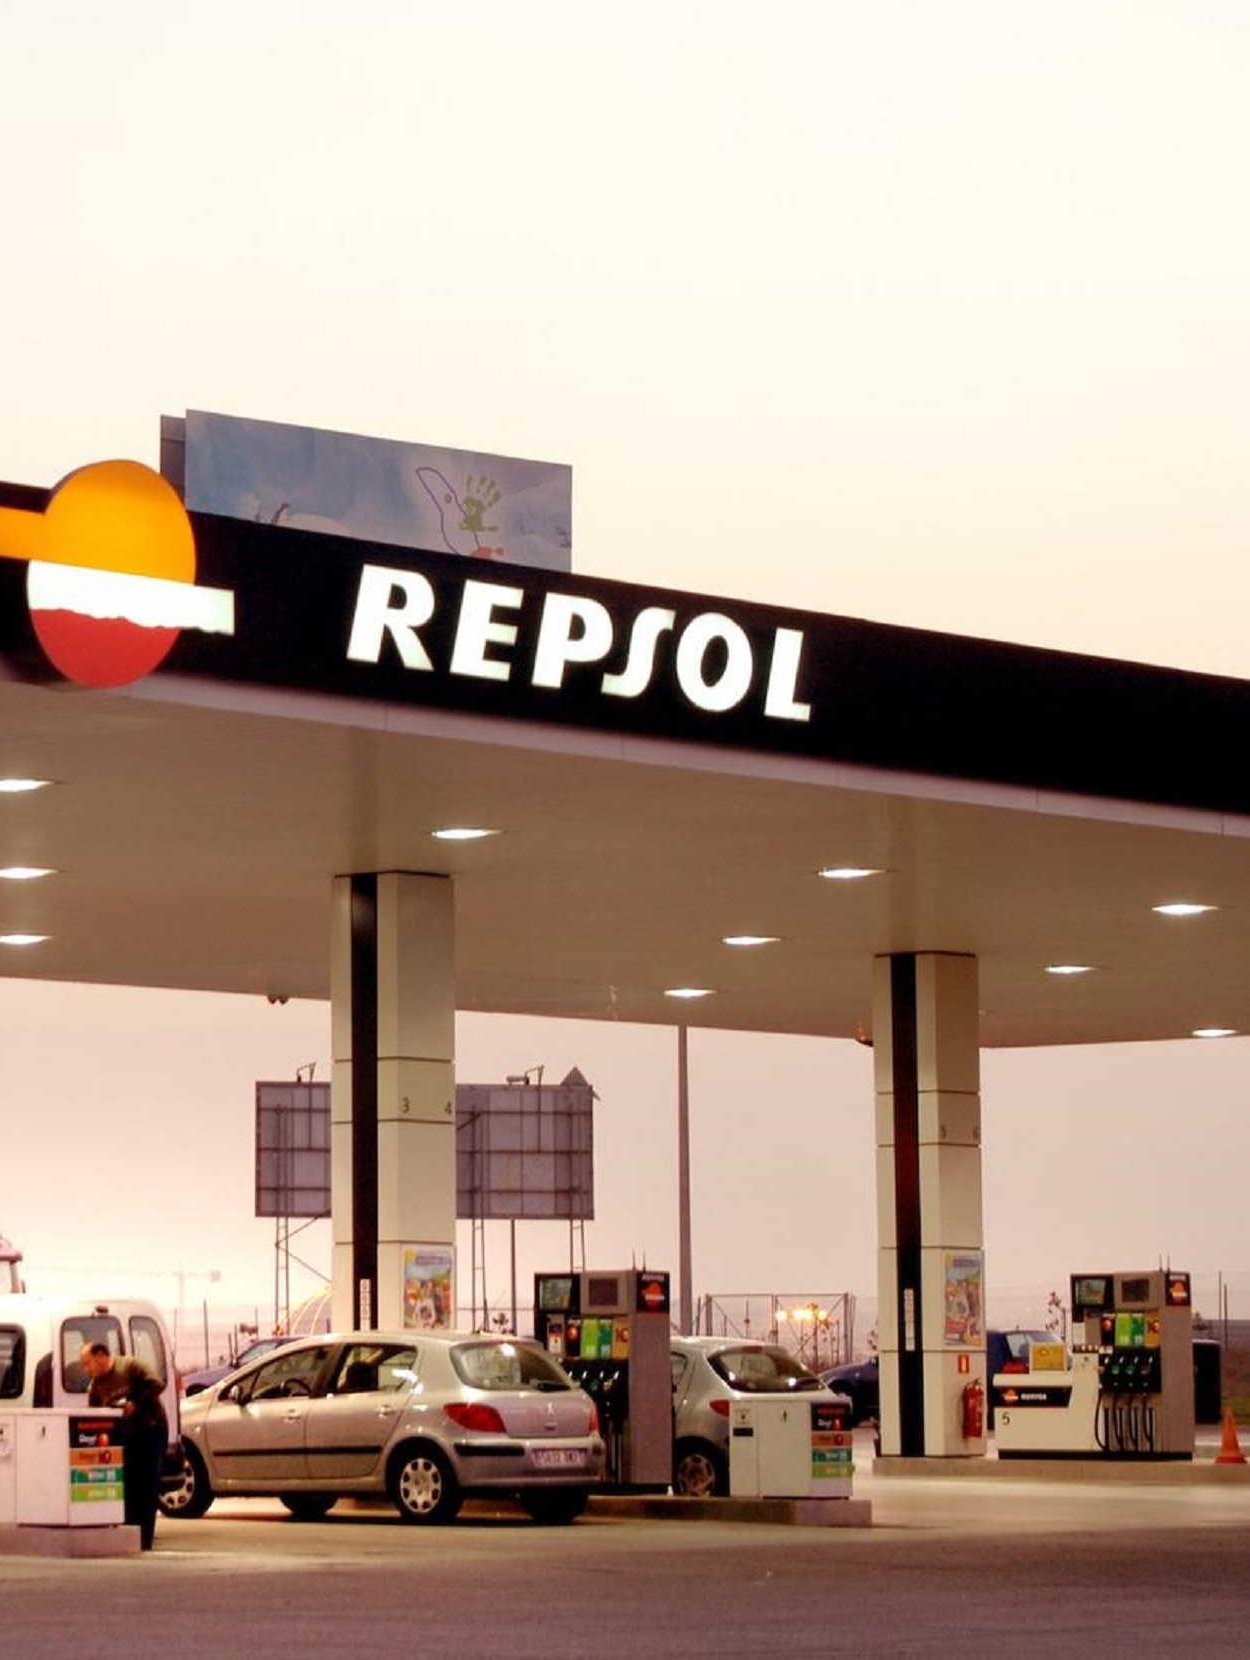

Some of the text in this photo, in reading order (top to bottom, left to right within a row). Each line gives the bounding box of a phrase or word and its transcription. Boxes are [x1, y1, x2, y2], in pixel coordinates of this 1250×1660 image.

[346, 563, 811, 722] REPSOL
[401, 1096, 410, 1113] 3
[1001, 1411, 1011, 1426] 5
